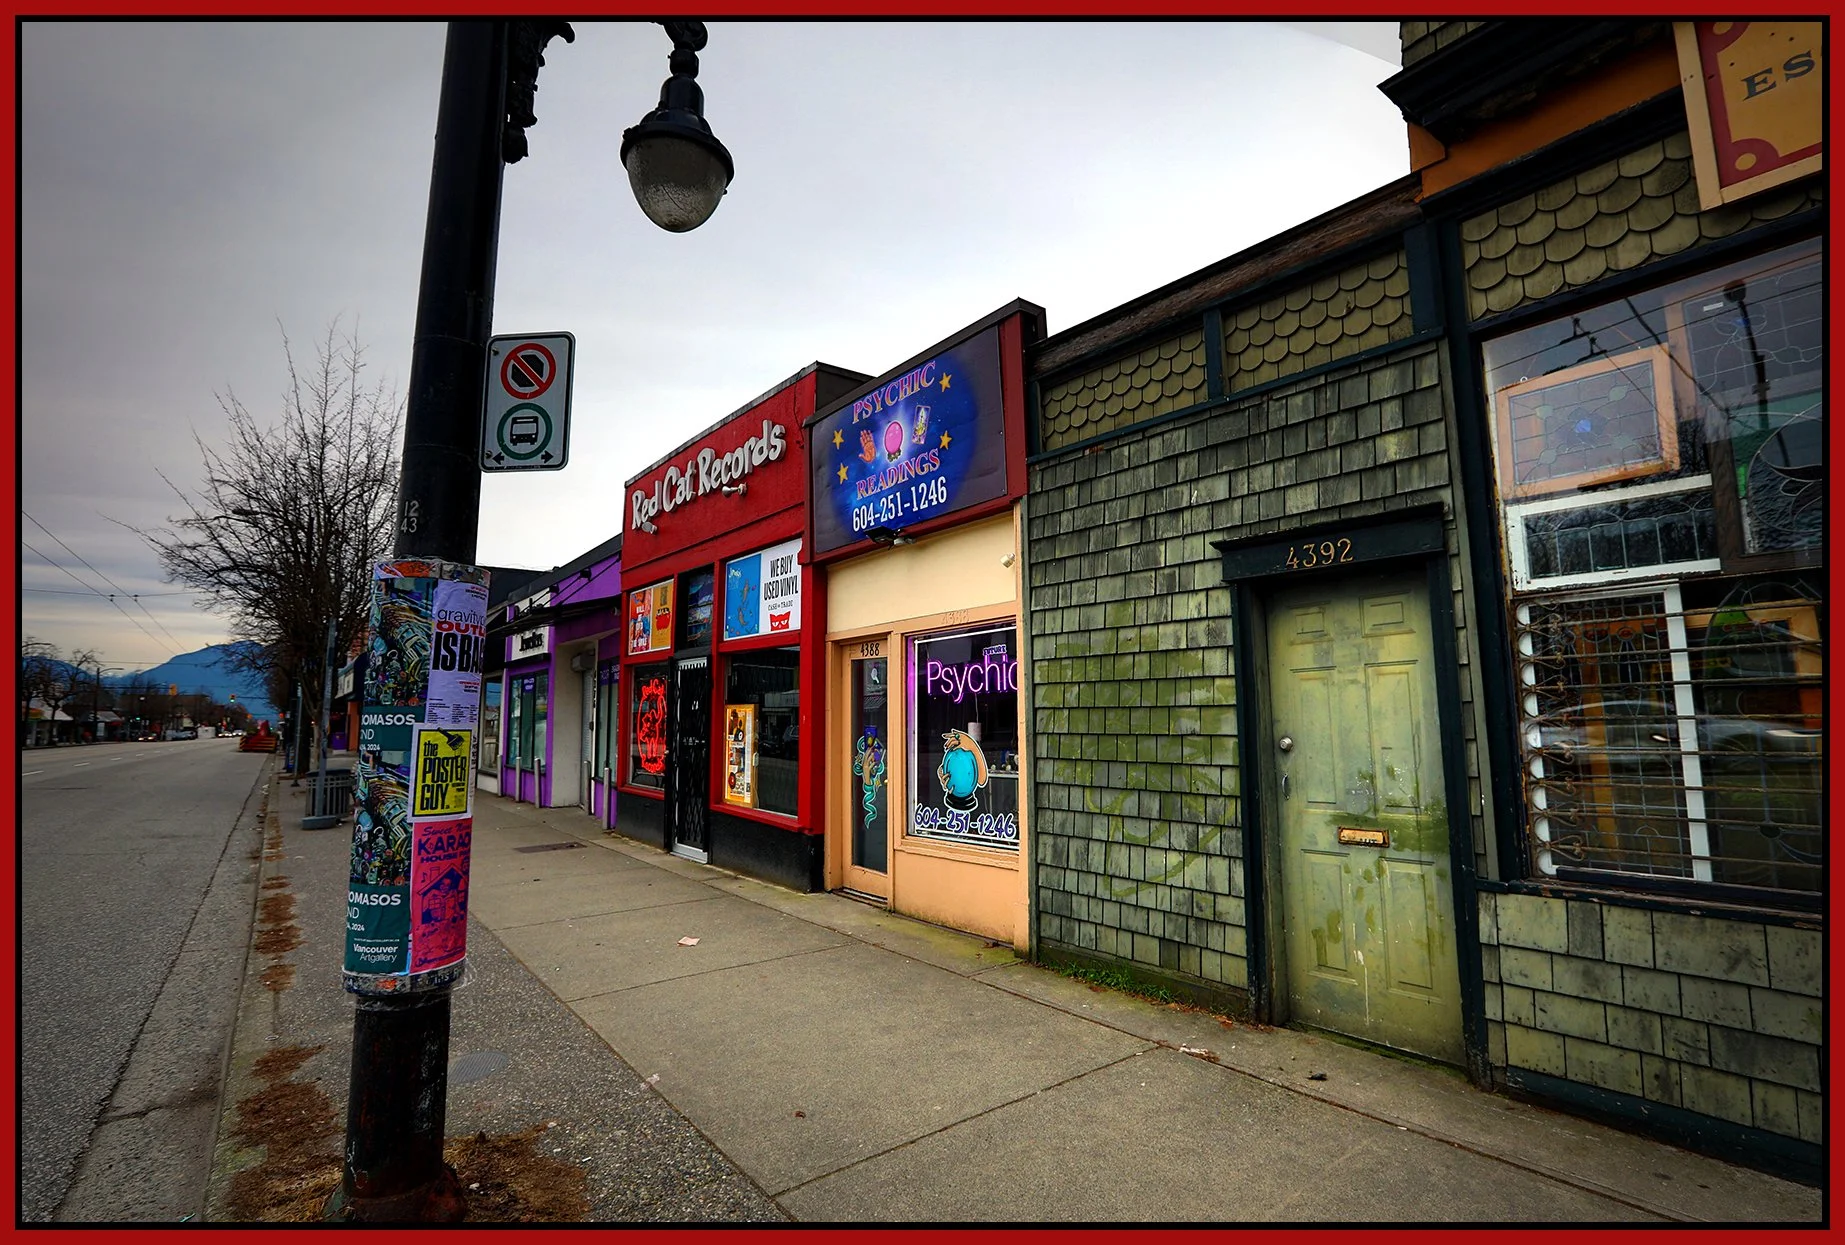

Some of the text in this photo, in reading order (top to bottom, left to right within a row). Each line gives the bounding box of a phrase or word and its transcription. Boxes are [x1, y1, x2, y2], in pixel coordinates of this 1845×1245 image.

[1740, 49, 1822, 101] ES
[852, 361, 936, 425] PSYCHIC
[631, 420, 787, 530] Red Cat Records
[855, 448, 941, 500] READINGS
[404, 500, 420, 517] 12
[852, 476, 947, 532] 604-251-1246
[400, 517, 417, 533] 43
[770, 554, 793, 578] WE BUY
[1284, 537, 1354, 569] 4392
[763, 575, 798, 601] USED VINYL
[860, 642, 880, 657] 4388
[926, 654, 1018, 703] Psychic
[423, 740, 439, 757] the
[421, 755, 467, 783] POSTER
[915, 803, 1017, 839] 604-251-1246
[420, 852, 458, 864] HOUSE
[351, 923, 365, 931] 2024
[353, 943, 398, 953] Vancouver
[360, 953, 397, 963] Artgallery
